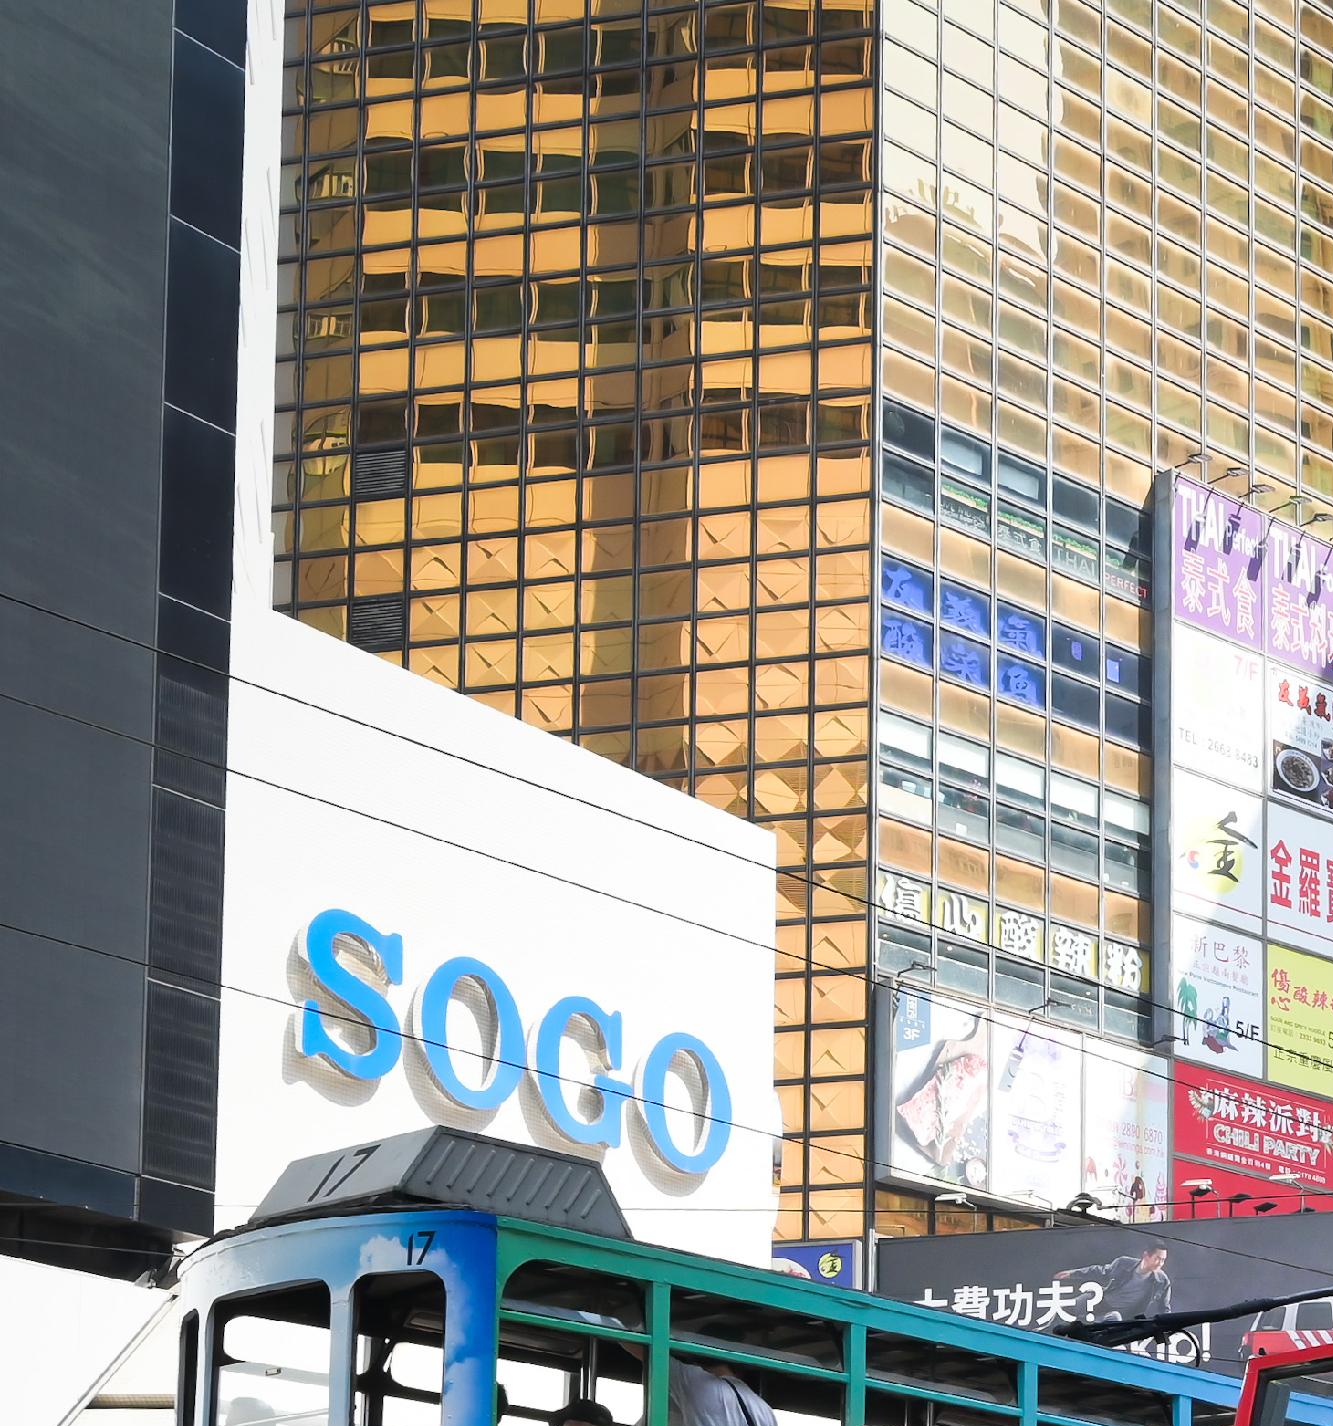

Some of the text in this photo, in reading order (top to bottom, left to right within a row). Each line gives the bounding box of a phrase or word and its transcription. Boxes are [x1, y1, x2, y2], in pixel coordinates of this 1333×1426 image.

[1104, 572, 1149, 599] PERFECT
[295, 907, 735, 1176] SOGO
[903, 1027, 921, 1041] 3F
[1235, 1019, 1260, 1042] 5/F
[1263, 1135, 1321, 1166] PARTY
[308, 1144, 381, 1202] 17
[406, 1231, 437, 1267] 17
